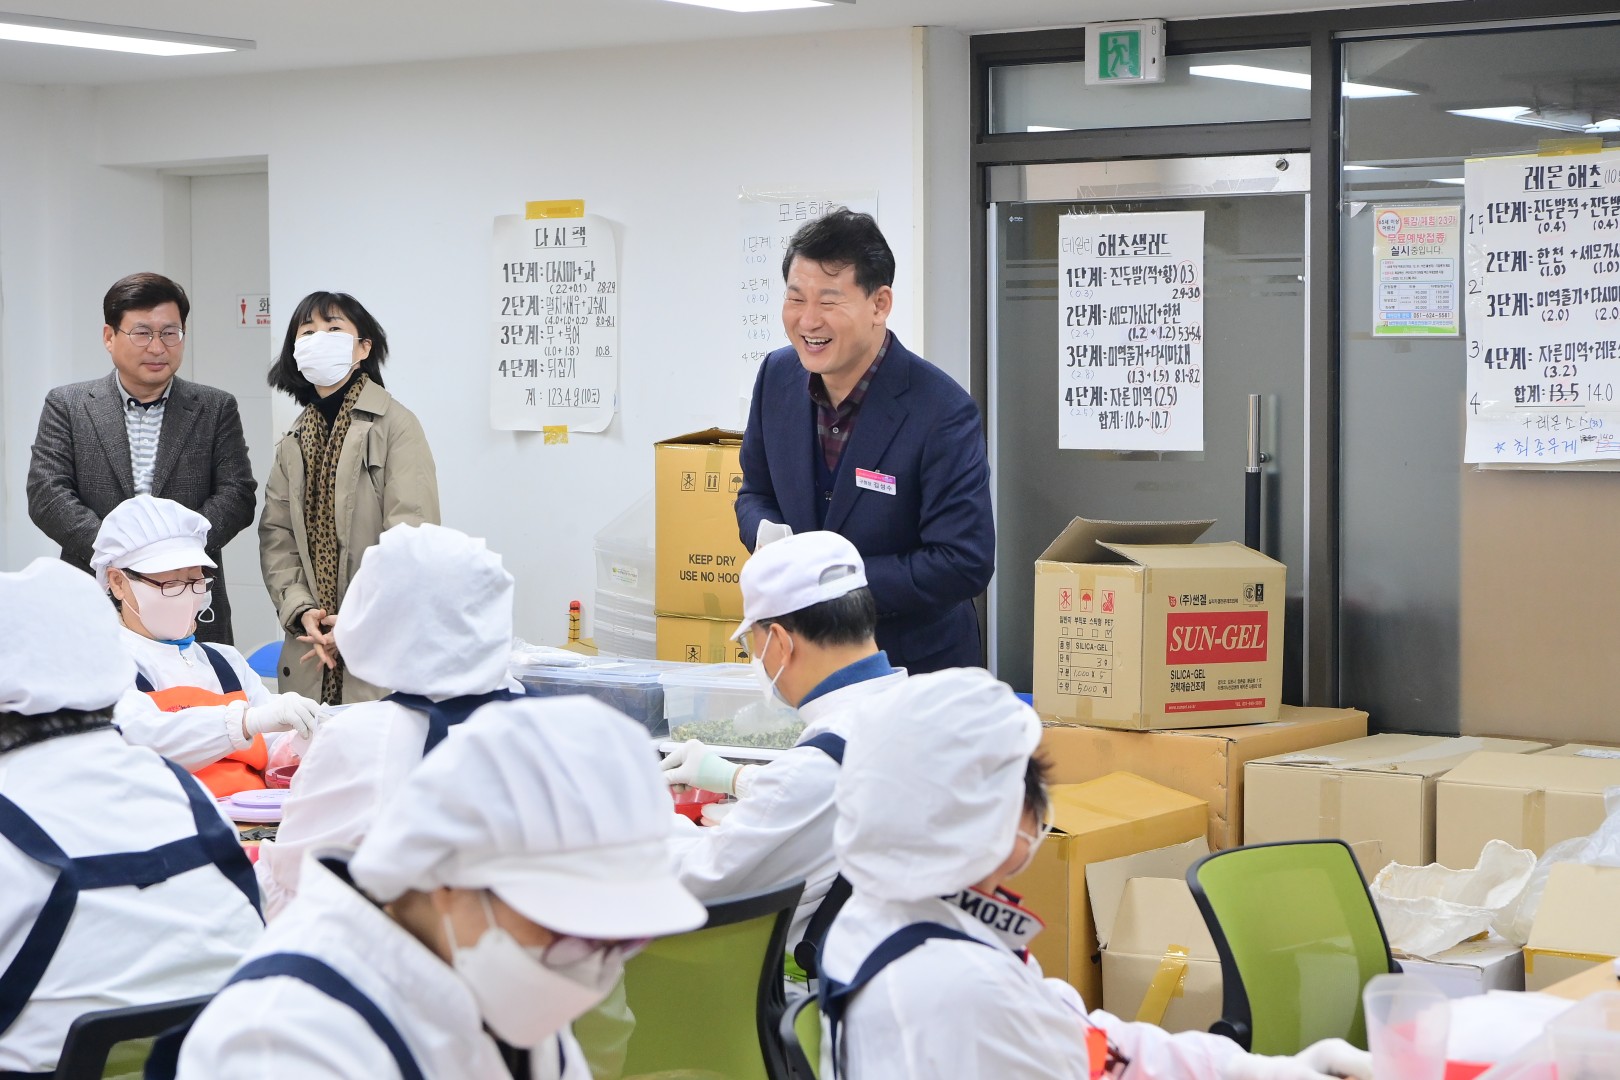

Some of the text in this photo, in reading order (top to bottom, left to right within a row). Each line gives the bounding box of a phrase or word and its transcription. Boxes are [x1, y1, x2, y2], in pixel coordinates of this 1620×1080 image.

[1524, 165, 1562, 190] 레몬
[1568, 164, 1602, 188] 해초
[1487, 201, 1532, 224] 1단계:
[1534, 198, 1578, 221] 진두발적
[535, 226, 586, 247] 다시팩
[1538, 218, 1619, 234] (0.4) (0.4)
[1098, 233, 1172, 257] 해초샐러드
[1387, 232, 1445, 243] 무료예방접종
[1487, 250, 1534, 273] 2단계:
[1537, 246, 1564, 265] 한천
[503, 261, 544, 283] 1단계:
[1066, 266, 1107, 288] 1단계:
[1540, 264, 1567, 277] (1.0)
[501, 295, 544, 316] 2단계:
[1066, 303, 1107, 327] 2단계:
[1487, 292, 1534, 317] 3단계:
[1541, 309, 1570, 322] (2.0)
[500, 325, 544, 345] 3단계:
[1066, 344, 1107, 368] 3단계:
[1484, 346, 1533, 370] 4단계:
[498, 358, 544, 378] 4단계:
[1543, 364, 1578, 378] (3.2)
[1065, 386, 1108, 407] 4단계:
[1514, 384, 1546, 403] 합계:
[1588, 383, 1613, 402] 14.0
[689, 553, 736, 567] KEEP DRY
[679, 570, 740, 584] USE NO HOO
[1075, 642, 1108, 652] SILICA-GEL
[1169, 624, 1266, 652] SUN-GEL
[1170, 669, 1206, 680] SILICA-GEL
